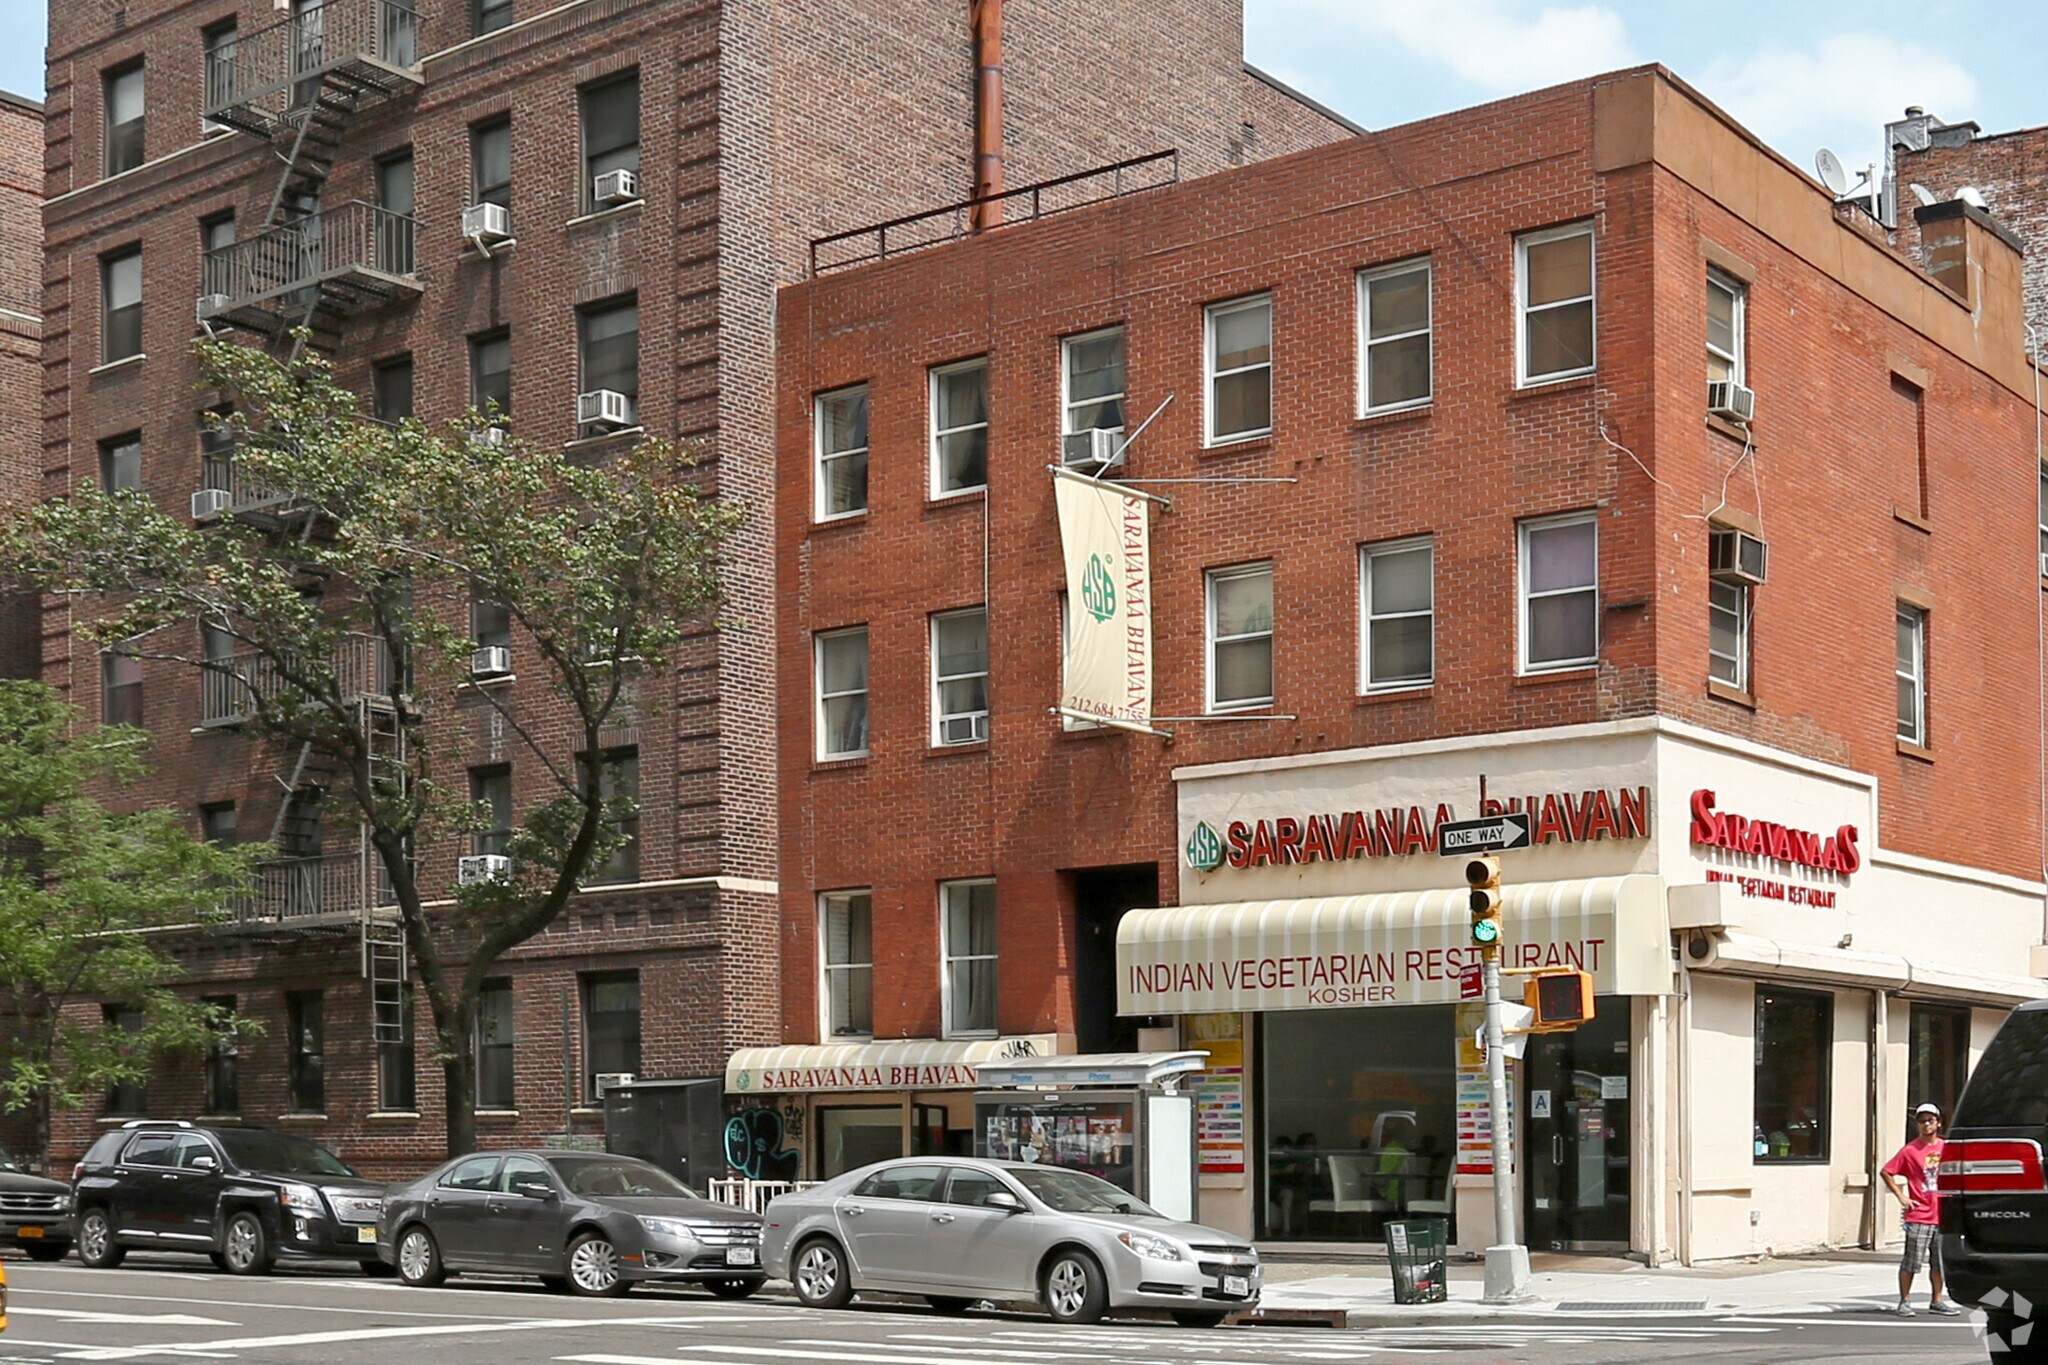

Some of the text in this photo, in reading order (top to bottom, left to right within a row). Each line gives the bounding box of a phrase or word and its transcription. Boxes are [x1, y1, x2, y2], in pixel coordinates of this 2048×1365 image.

[1122, 495, 1146, 712] SARAVANAA BHAVAN
[1448, 827, 1504, 845] ONE WAY
[1130, 961, 1214, 994] INDIAN
[1222, 952, 1395, 990] VEGETARIAN
[1405, 939, 1605, 982] RESTURANT
[1308, 986, 1396, 1004] KOSHER
[763, 1068, 882, 1088] SARAVANAA
[890, 1064, 978, 1085] BHAVAN
[1088, 1072, 1111, 1080] Phone
[1535, 1095, 1547, 1109] A
